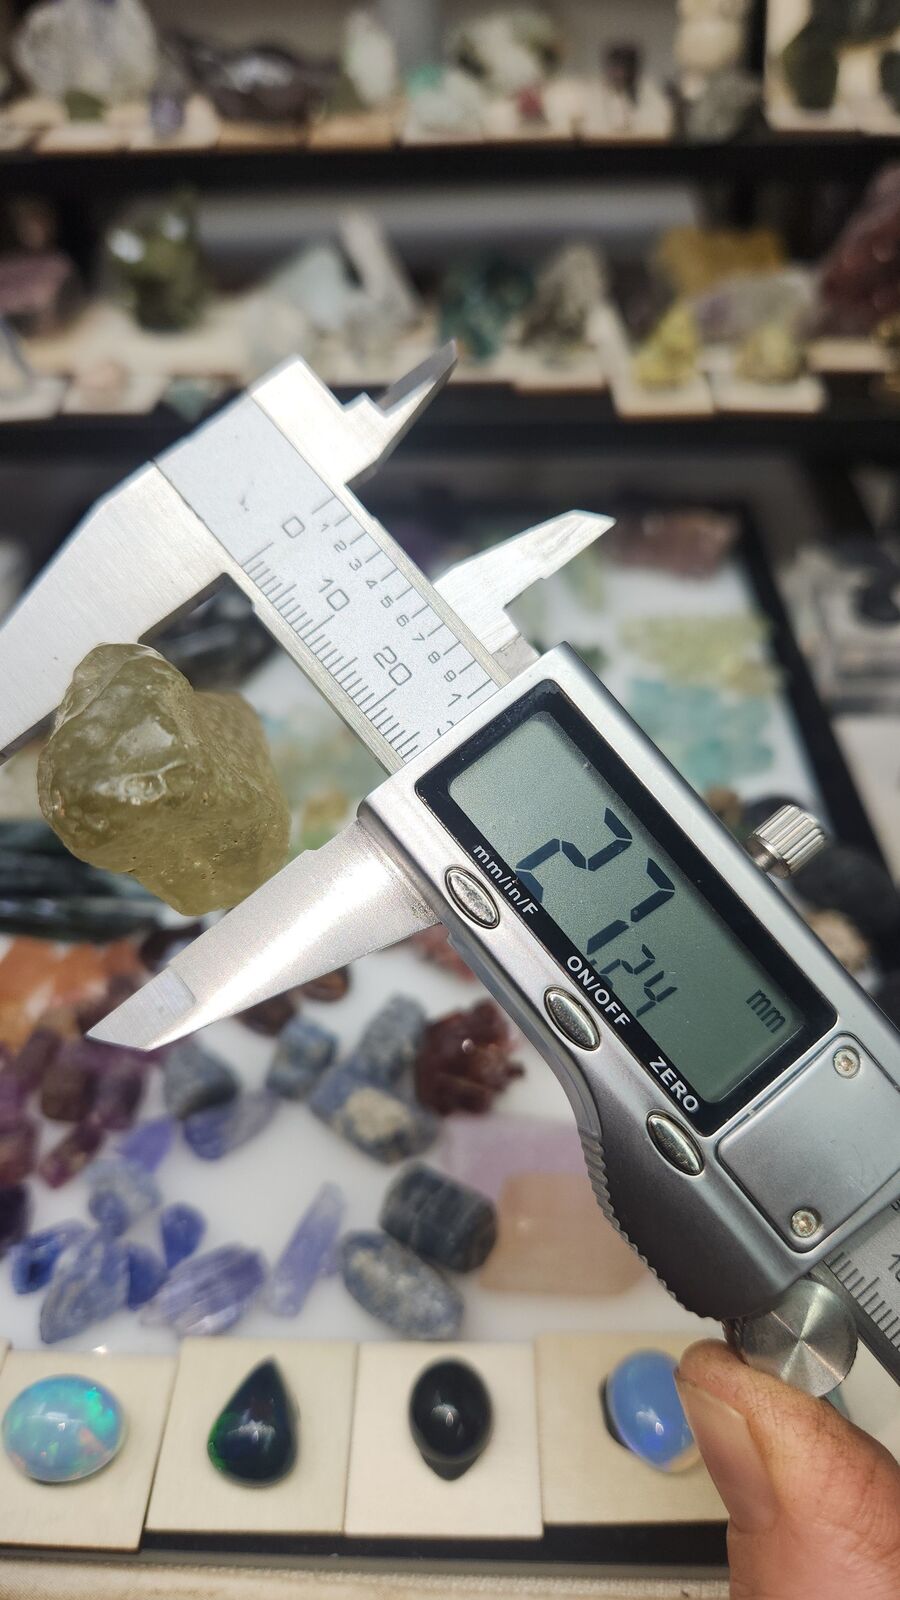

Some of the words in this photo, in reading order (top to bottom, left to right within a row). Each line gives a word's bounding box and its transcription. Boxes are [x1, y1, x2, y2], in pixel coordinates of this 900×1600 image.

[281, 515, 306, 539] 0
[318, 578, 351, 612] 10
[373, 645, 413, 686] 20
[320, 522, 330, 533] 1
[333, 539, 348, 553] 2
[348, 558, 363, 572] 3
[365, 579, 379, 590] 4
[380, 595, 395, 609] 5
[396, 614, 410, 628] 6
[411, 632, 426, 643] 7
[427, 650, 442, 665] 8
[443, 669, 457, 683] 9
[472, 844, 539, 916] mm/in/F
[565, 955, 631, 1027] ON/OFF
[745, 988, 787, 1034] mm
[649, 1055, 700, 1114] ZERO
